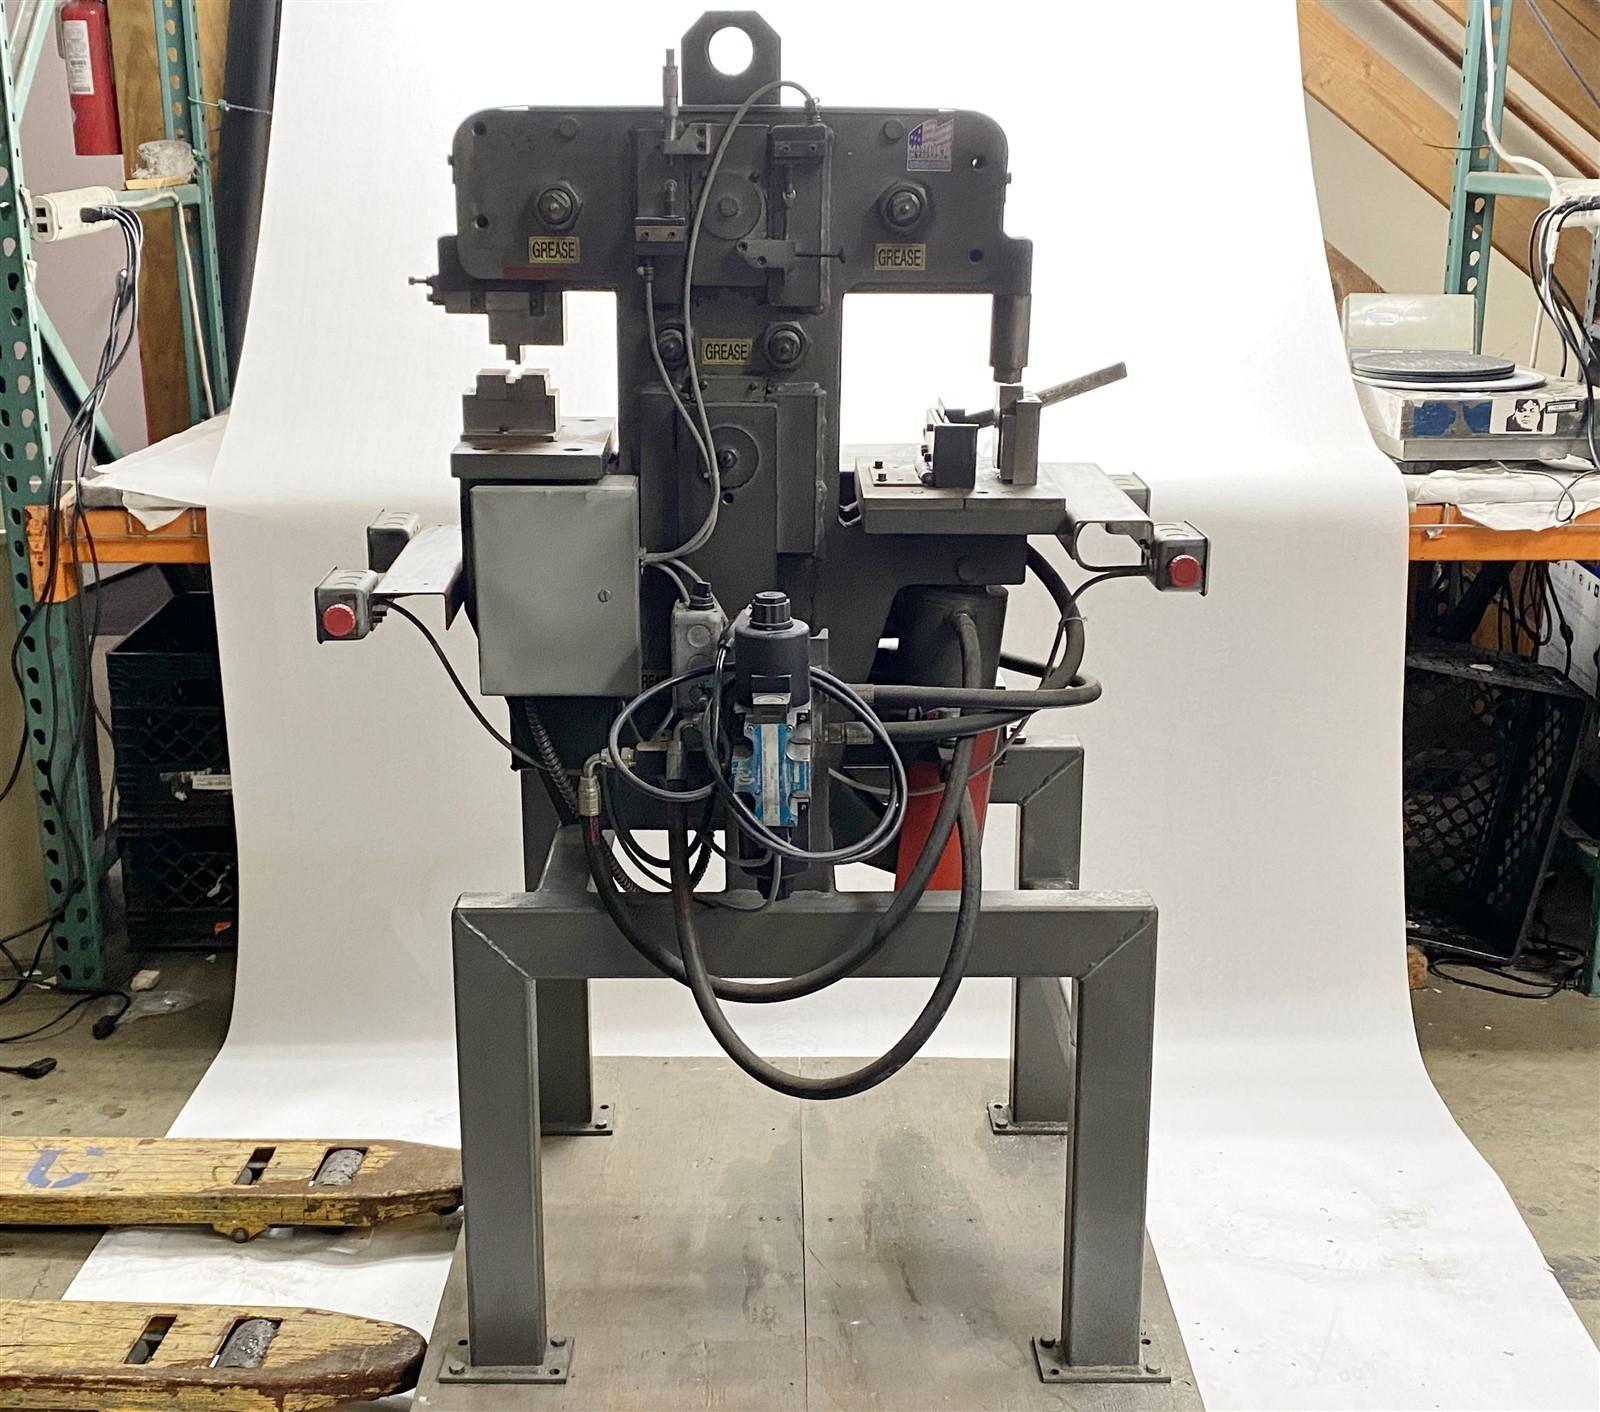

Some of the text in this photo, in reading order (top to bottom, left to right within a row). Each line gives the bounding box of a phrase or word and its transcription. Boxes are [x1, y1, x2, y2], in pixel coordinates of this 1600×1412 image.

[532, 241, 575, 259] GREASE
[878, 249, 921, 266] GREASE
[706, 343, 748, 360] GREASE
